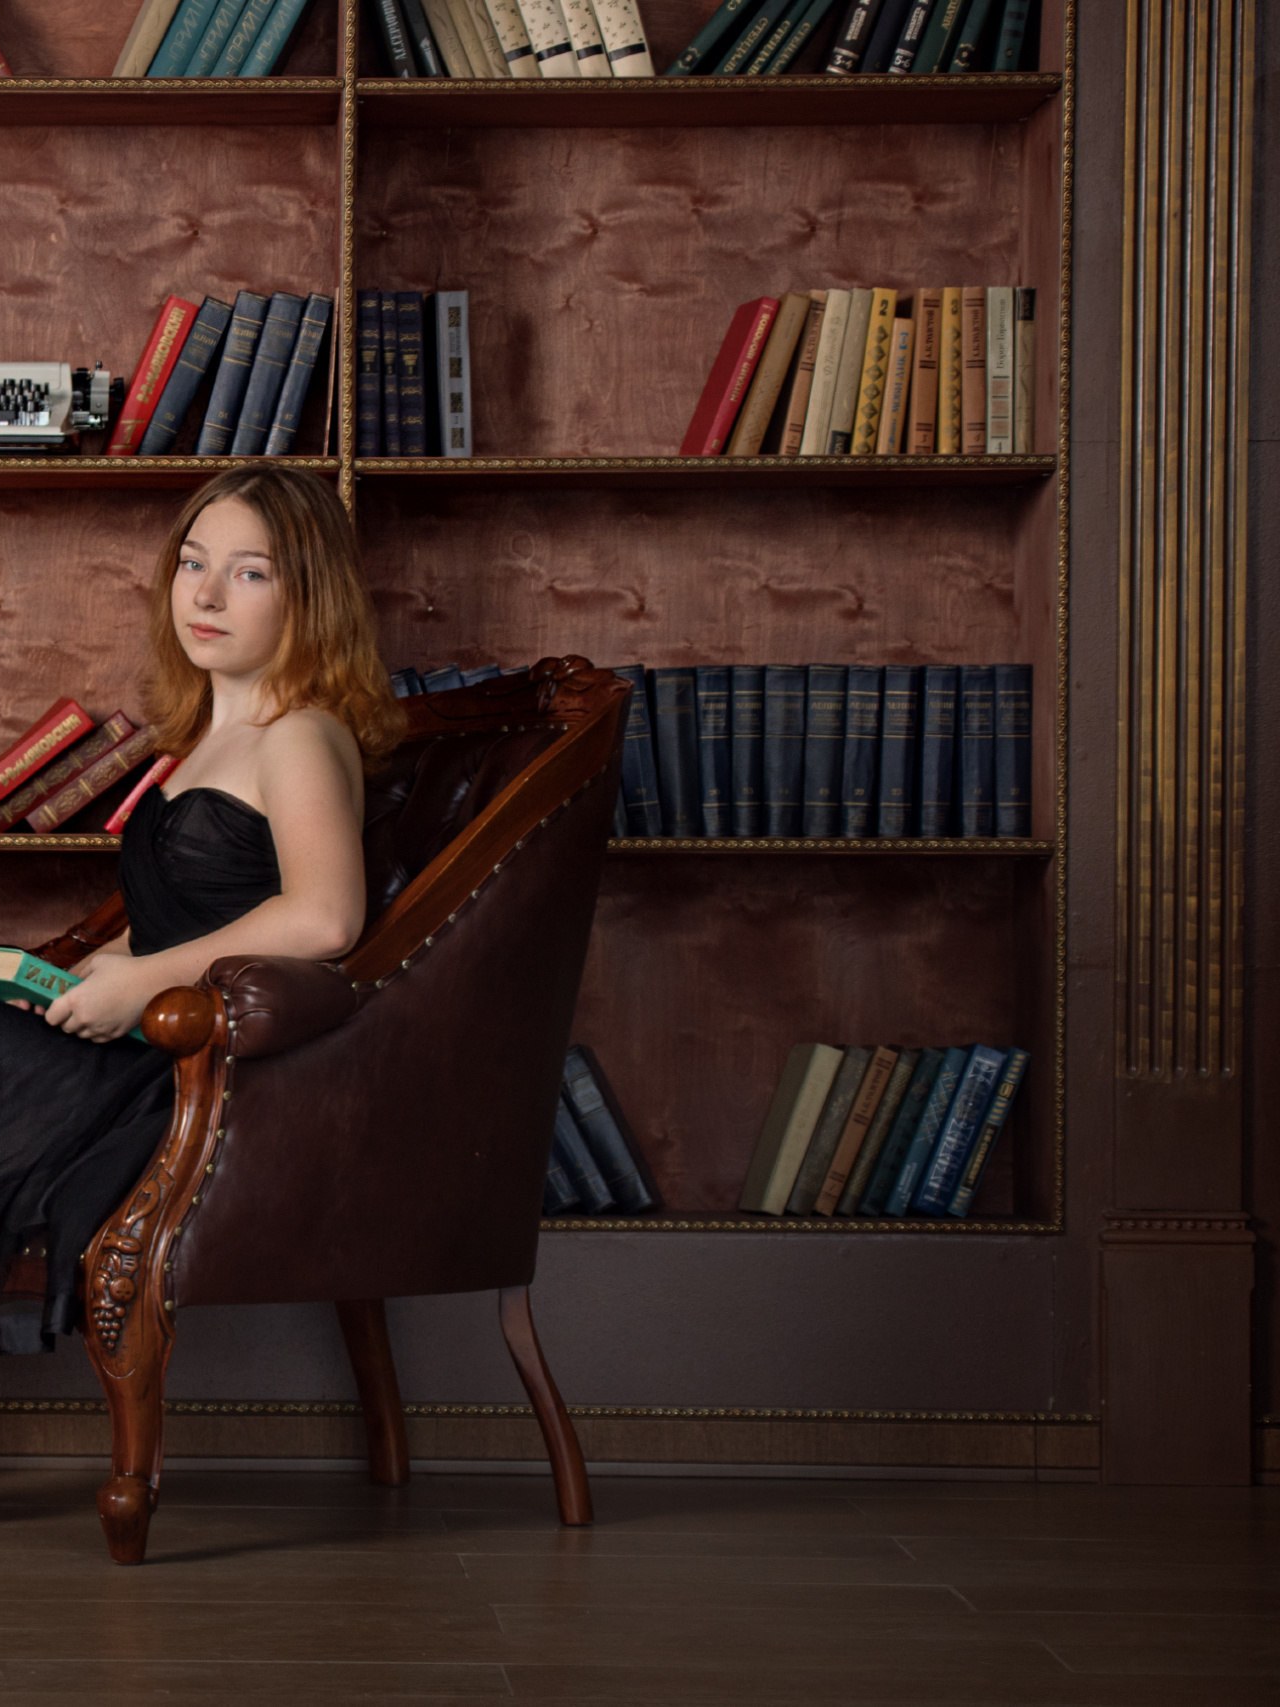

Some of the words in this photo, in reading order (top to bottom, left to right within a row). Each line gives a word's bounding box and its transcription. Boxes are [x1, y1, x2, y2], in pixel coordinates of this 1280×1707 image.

[723, 17, 768, 74] СТЕНДАЛЬ
[879, 300, 888, 315] 2
[730, 363, 751, 402] МИХАИЛ
[747, 313, 770, 360] ШОЛОХОВ
